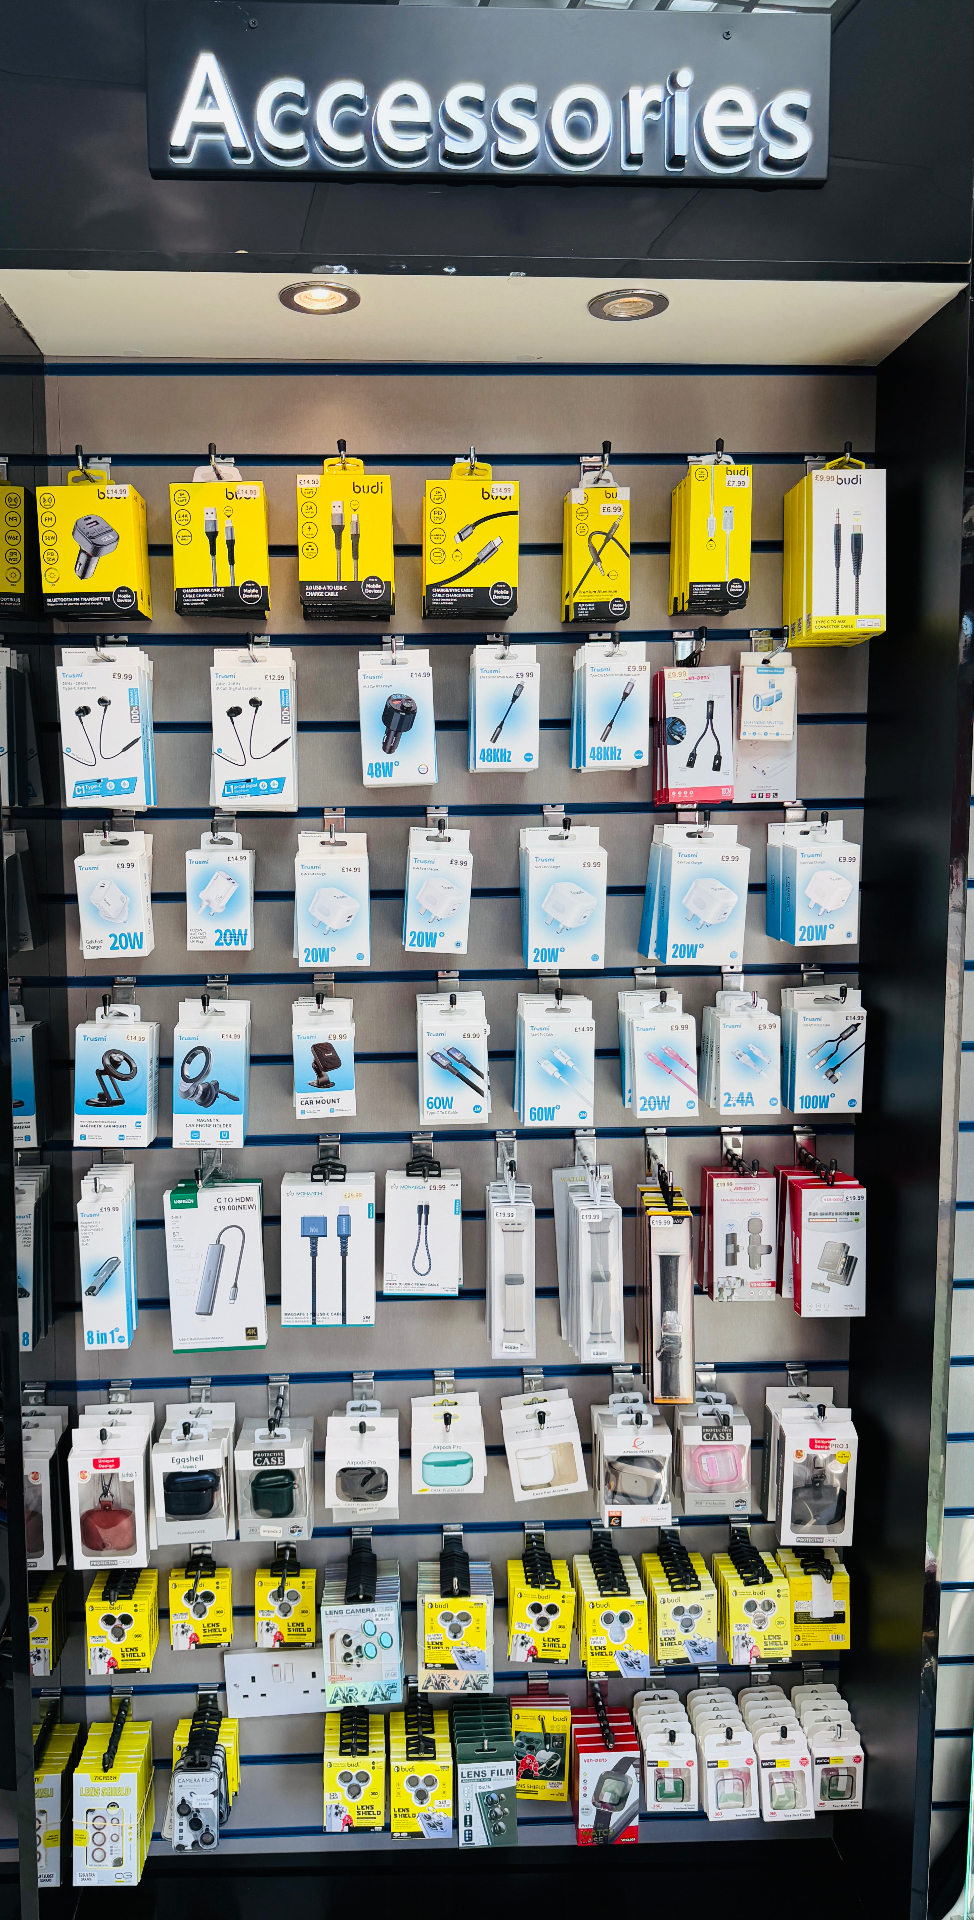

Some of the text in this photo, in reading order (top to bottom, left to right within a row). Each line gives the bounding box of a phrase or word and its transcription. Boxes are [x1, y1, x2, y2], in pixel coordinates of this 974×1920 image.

[169, 52, 812, 174] Accessories
[726, 467, 749, 476] budi
[836, 475, 862, 485] budi
[353, 482, 383, 494] budi
[479, 749, 511, 762] 48KHz
[589, 746, 622, 760] 48KHz
[75, 785, 85, 794] C1
[225, 785, 234, 794] L1
[109, 932, 144, 950] 20W
[214, 929, 248, 946] 20W
[426, 1096, 453, 1110] 60W
[639, 1095, 670, 1111] 20W
[723, 1092, 755, 1107] 2.4A
[87, 1330, 115, 1345] 8 in 1
[703, 1433, 732, 1441] CASE
[171, 1454, 204, 1464] Eggshell
[254, 1457, 284, 1466] CASE
[461, 1770, 487, 1778] LENS
[80, 1787, 131, 1797] LENS SHIELD
